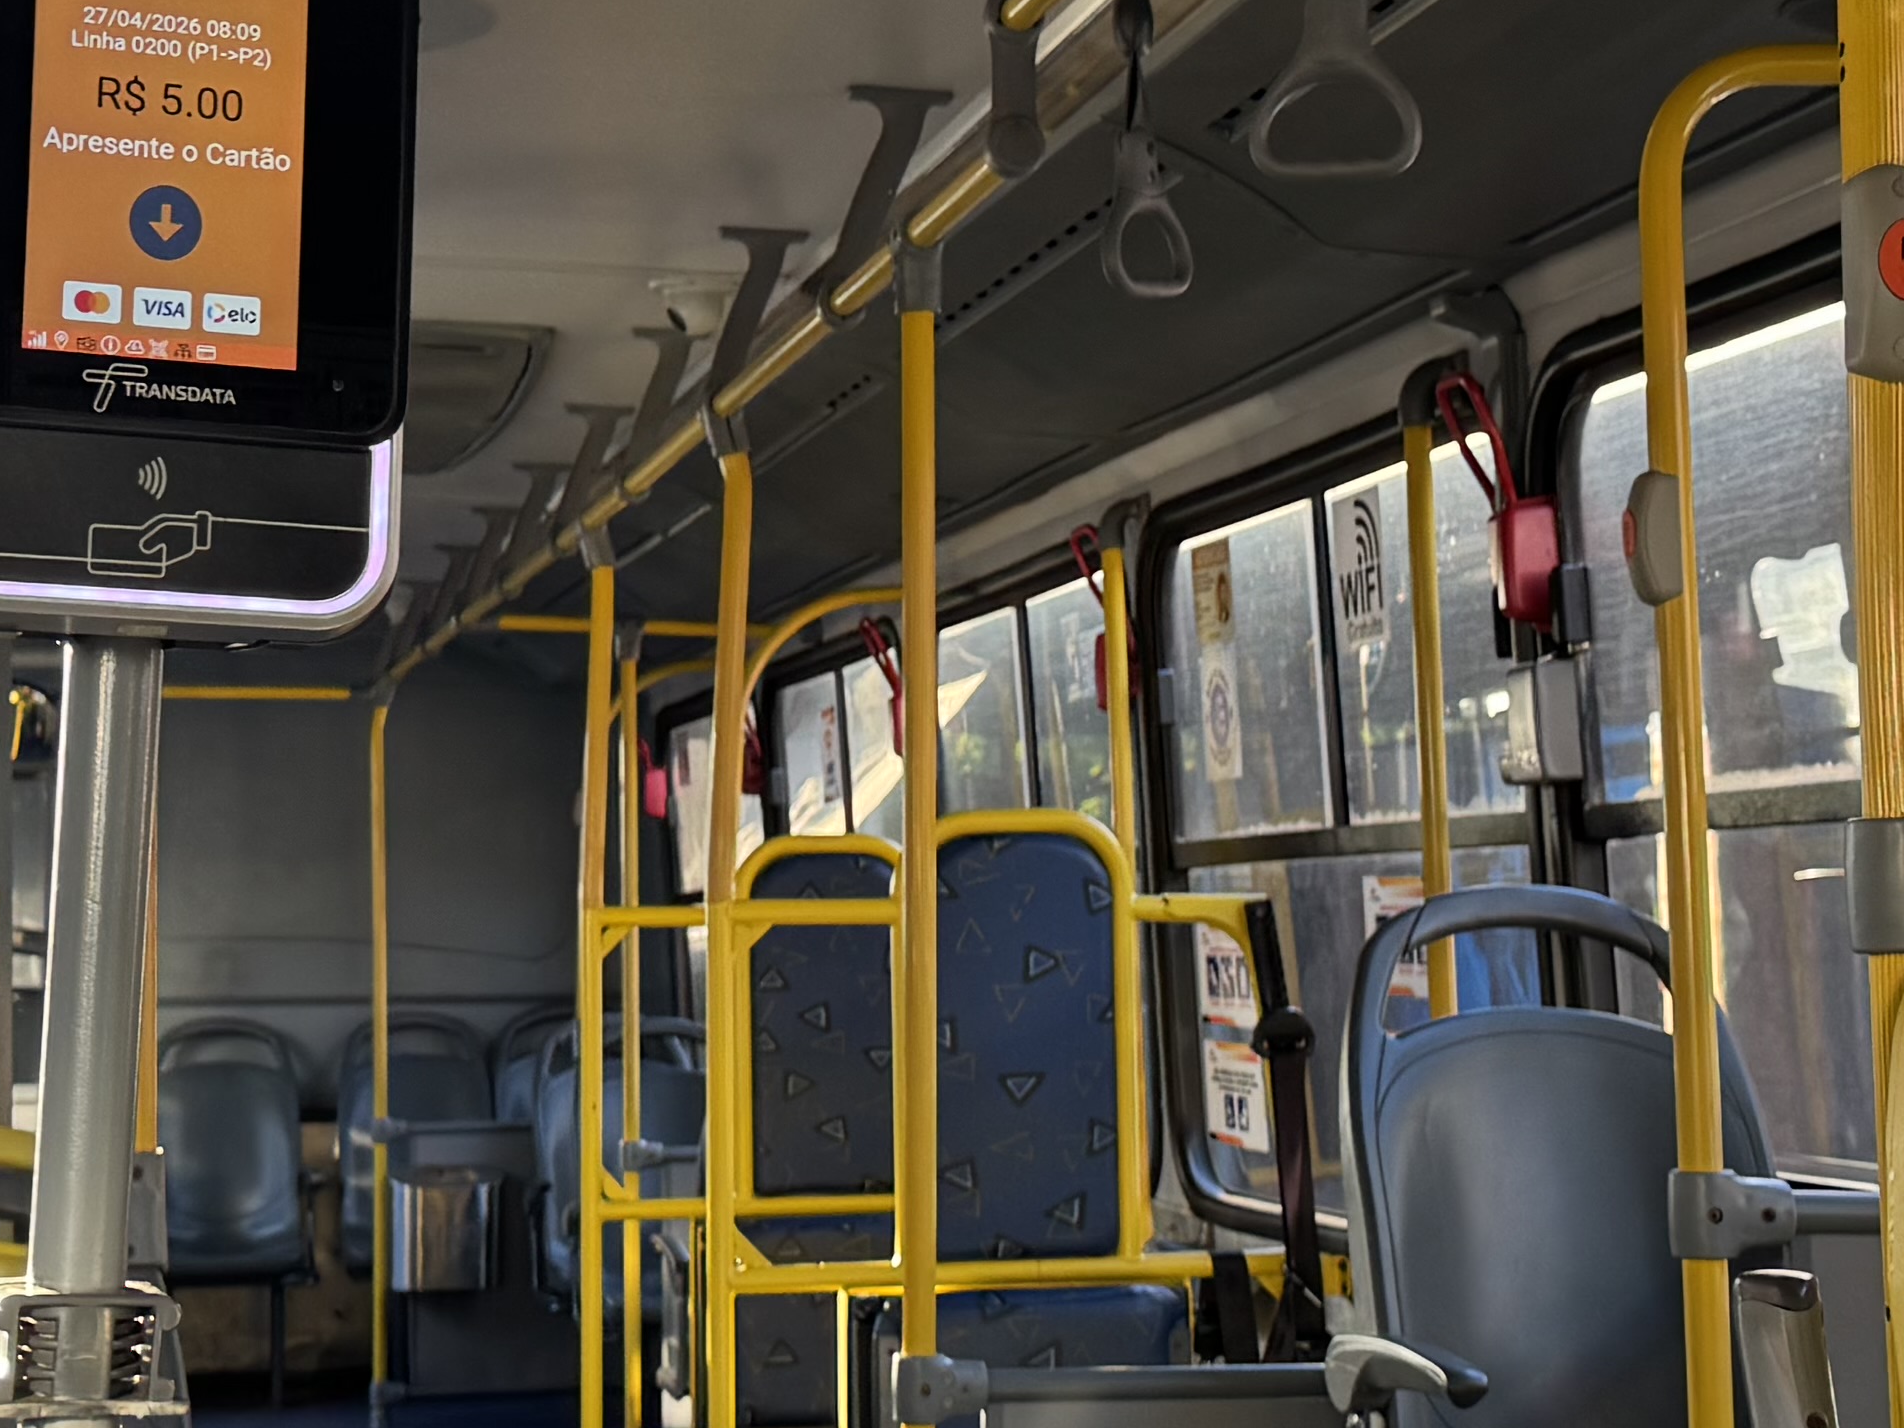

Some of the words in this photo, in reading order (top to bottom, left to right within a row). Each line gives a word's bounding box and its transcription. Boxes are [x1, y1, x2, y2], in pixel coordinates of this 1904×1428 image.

[83, 6, 201, 35] 27/04/2026
[206, 19, 261, 42] 08:09
[71, 29, 126, 52] Linha
[131, 36, 182, 58] 0200
[188, 40, 272, 71] (P1->P2)
[97, 75, 146, 116] R$
[161, 83, 243, 122] 5.00
[43, 126, 175, 160] Apresente
[182, 144, 198, 163] o
[206, 142, 292, 172] Cartão
[141, 299, 185, 318] VISA
[122, 380, 237, 406] TRANSDATA
